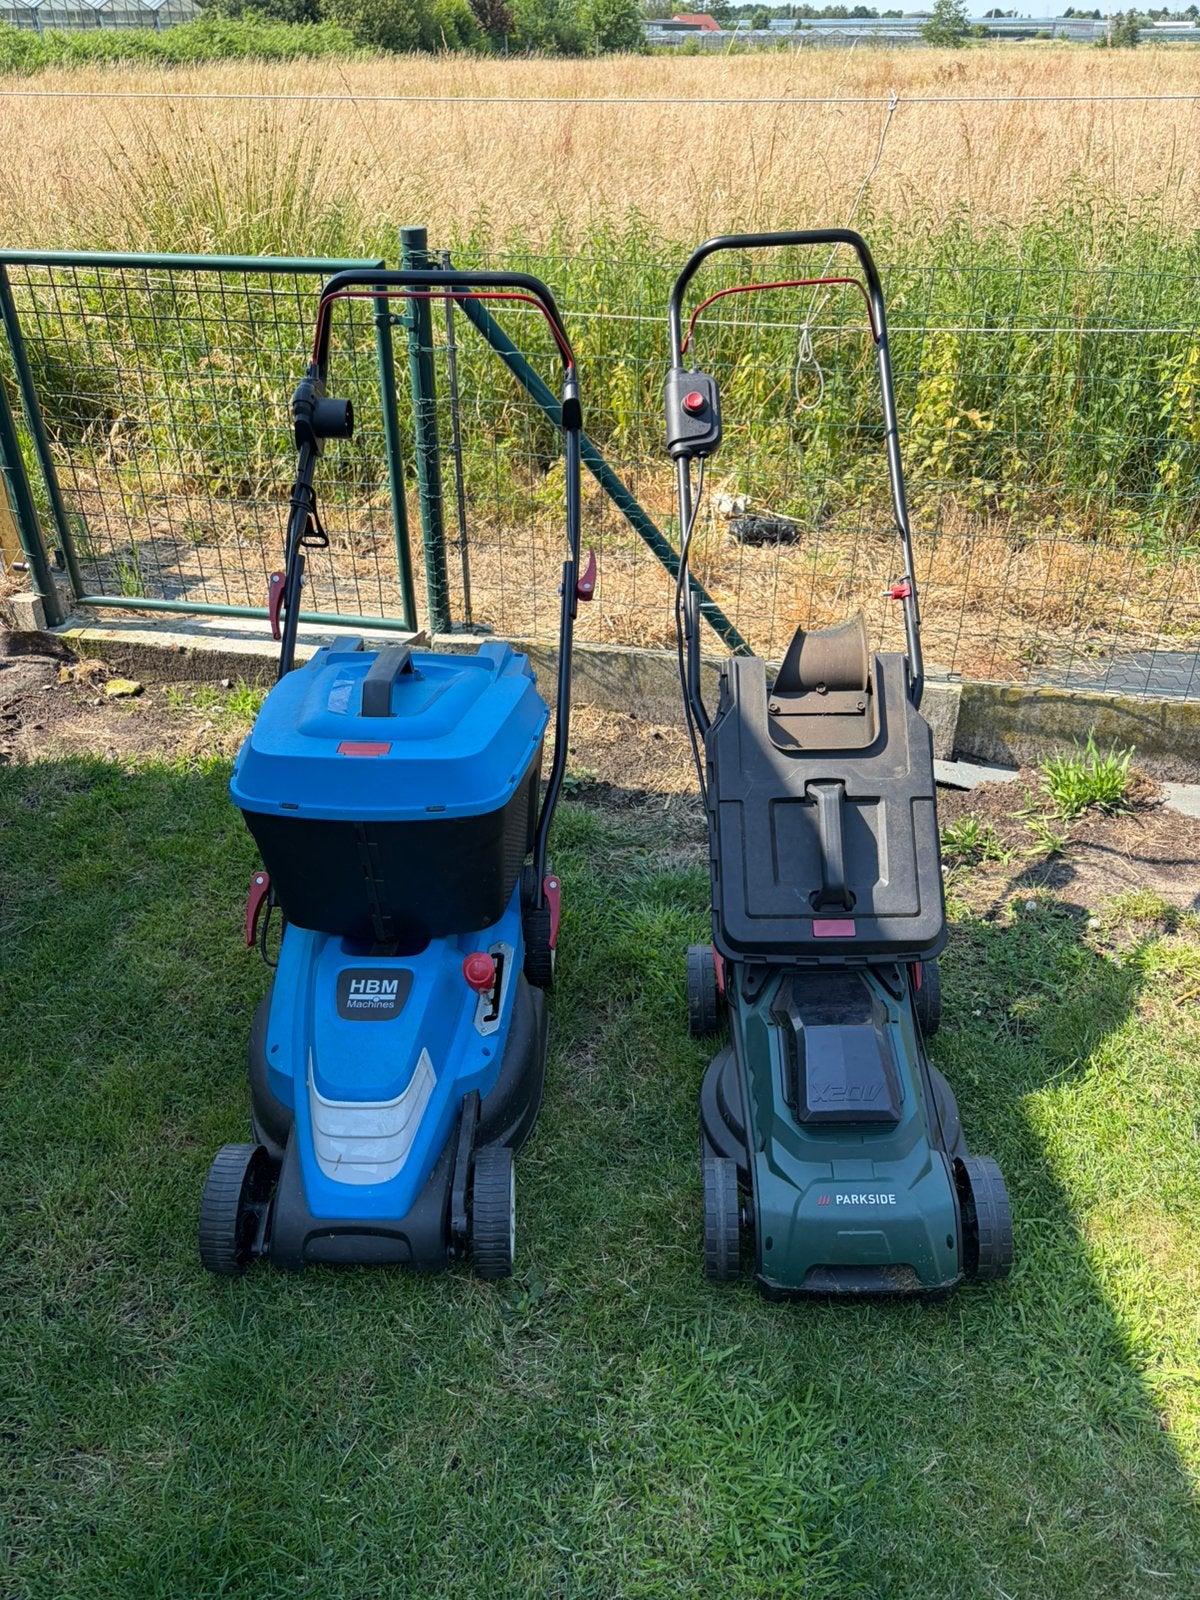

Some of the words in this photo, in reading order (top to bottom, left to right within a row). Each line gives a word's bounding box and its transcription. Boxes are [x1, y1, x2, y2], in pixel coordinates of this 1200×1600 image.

[349, 979, 398, 994] HBM
[346, 999, 395, 1009] Machines
[811, 1083, 884, 1103] X20V
[835, 1193, 897, 1206] PARKSIDE
